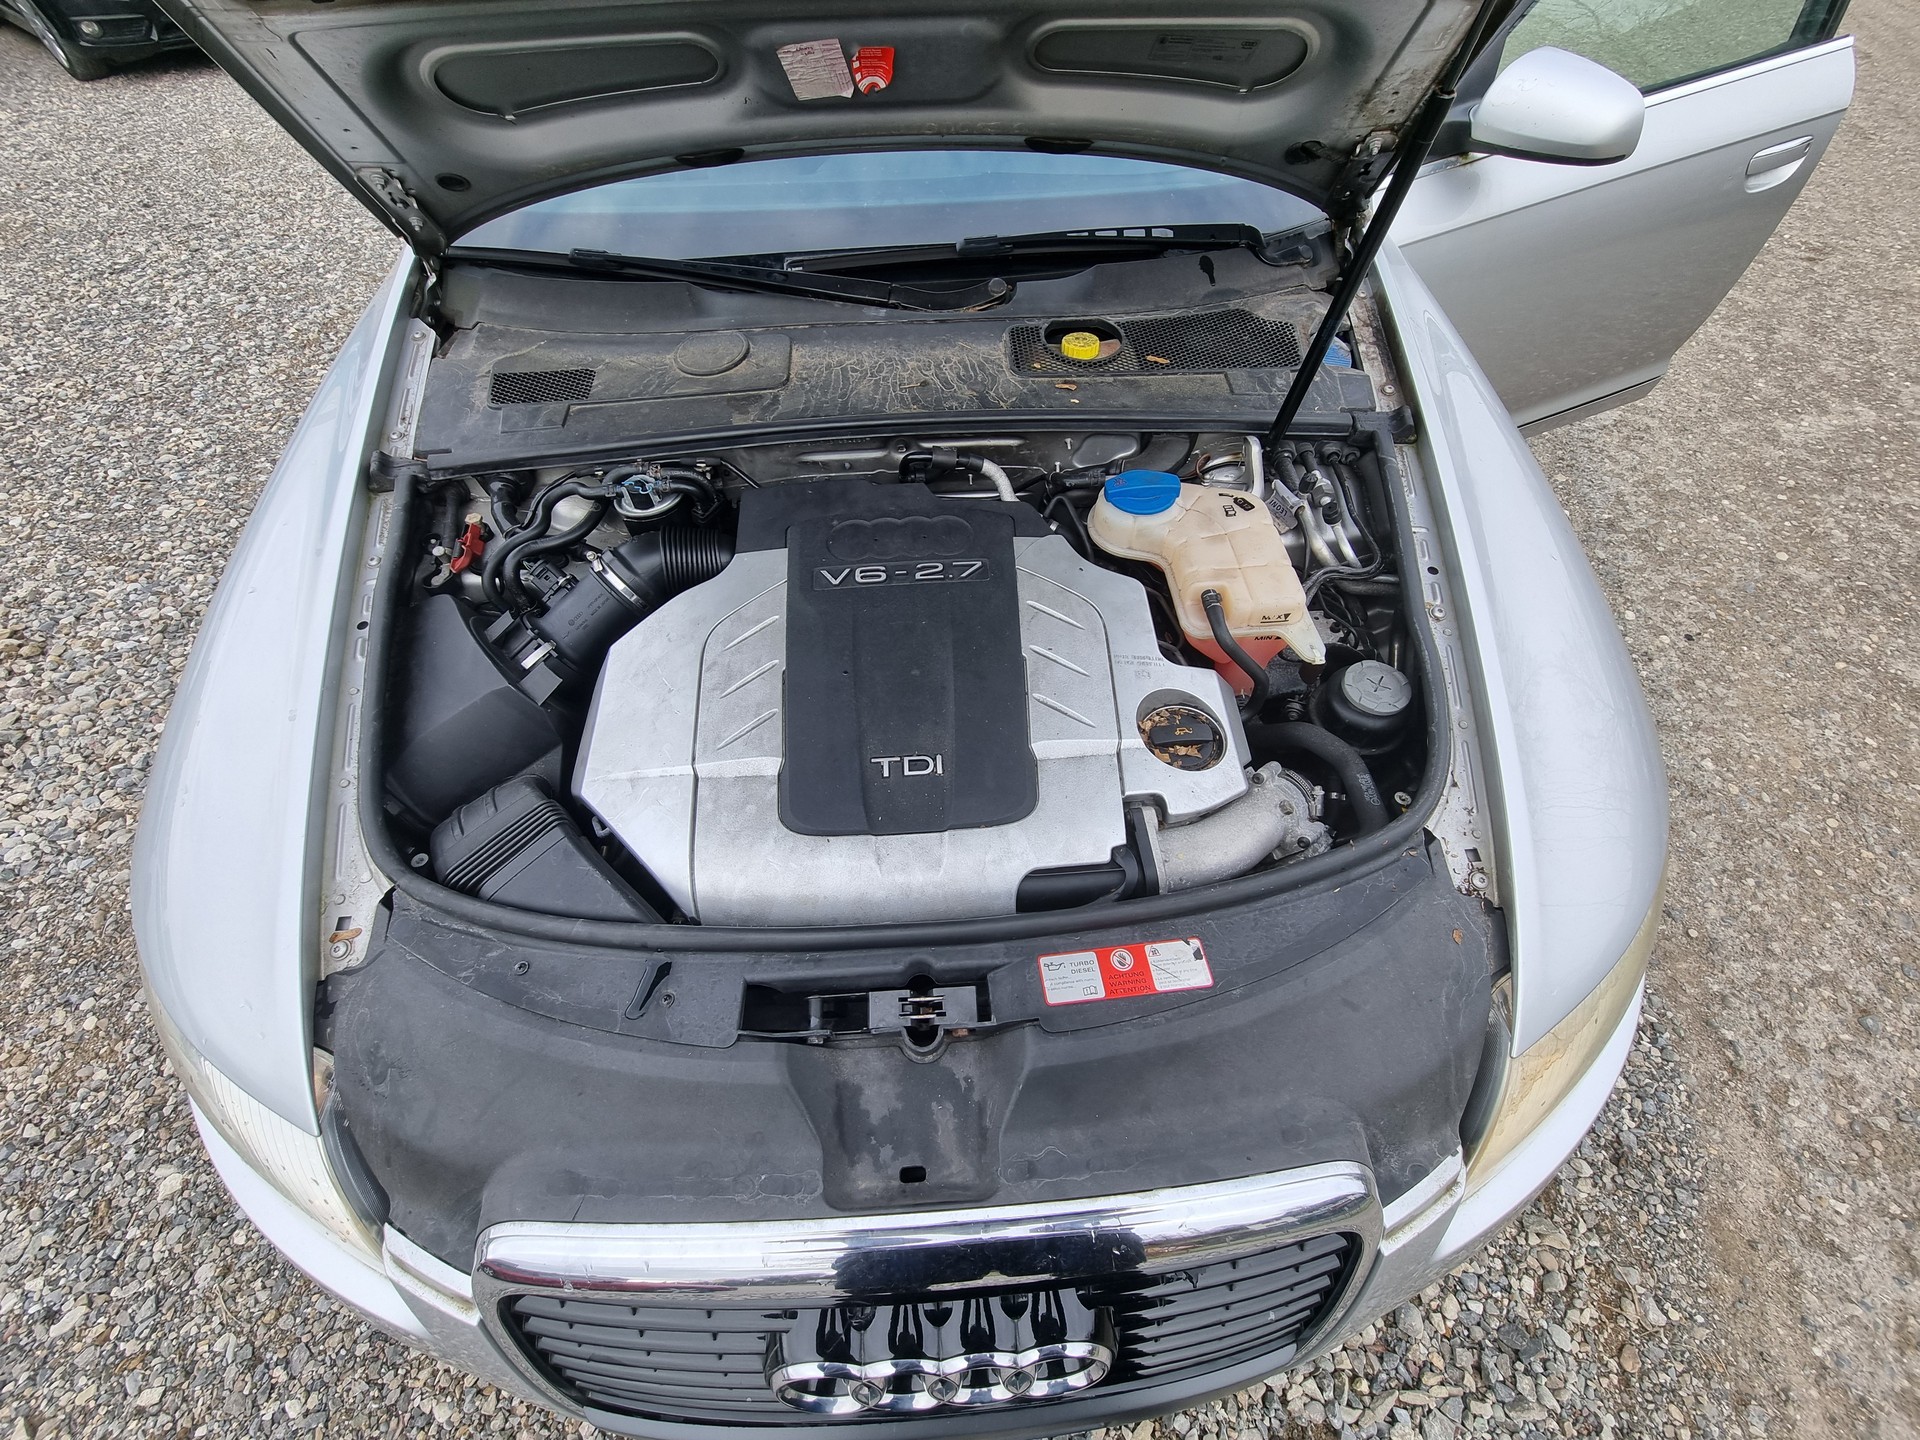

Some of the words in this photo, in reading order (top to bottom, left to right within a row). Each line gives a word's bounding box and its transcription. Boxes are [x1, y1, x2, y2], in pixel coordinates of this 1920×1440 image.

[1269, 499, 1288, 517] LEONI
[870, 753, 944, 778] TDI
[1069, 960, 1095, 968] TURBO
[1108, 971, 1145, 981] ACHTUNG
[1109, 978, 1147, 988] WARNING
